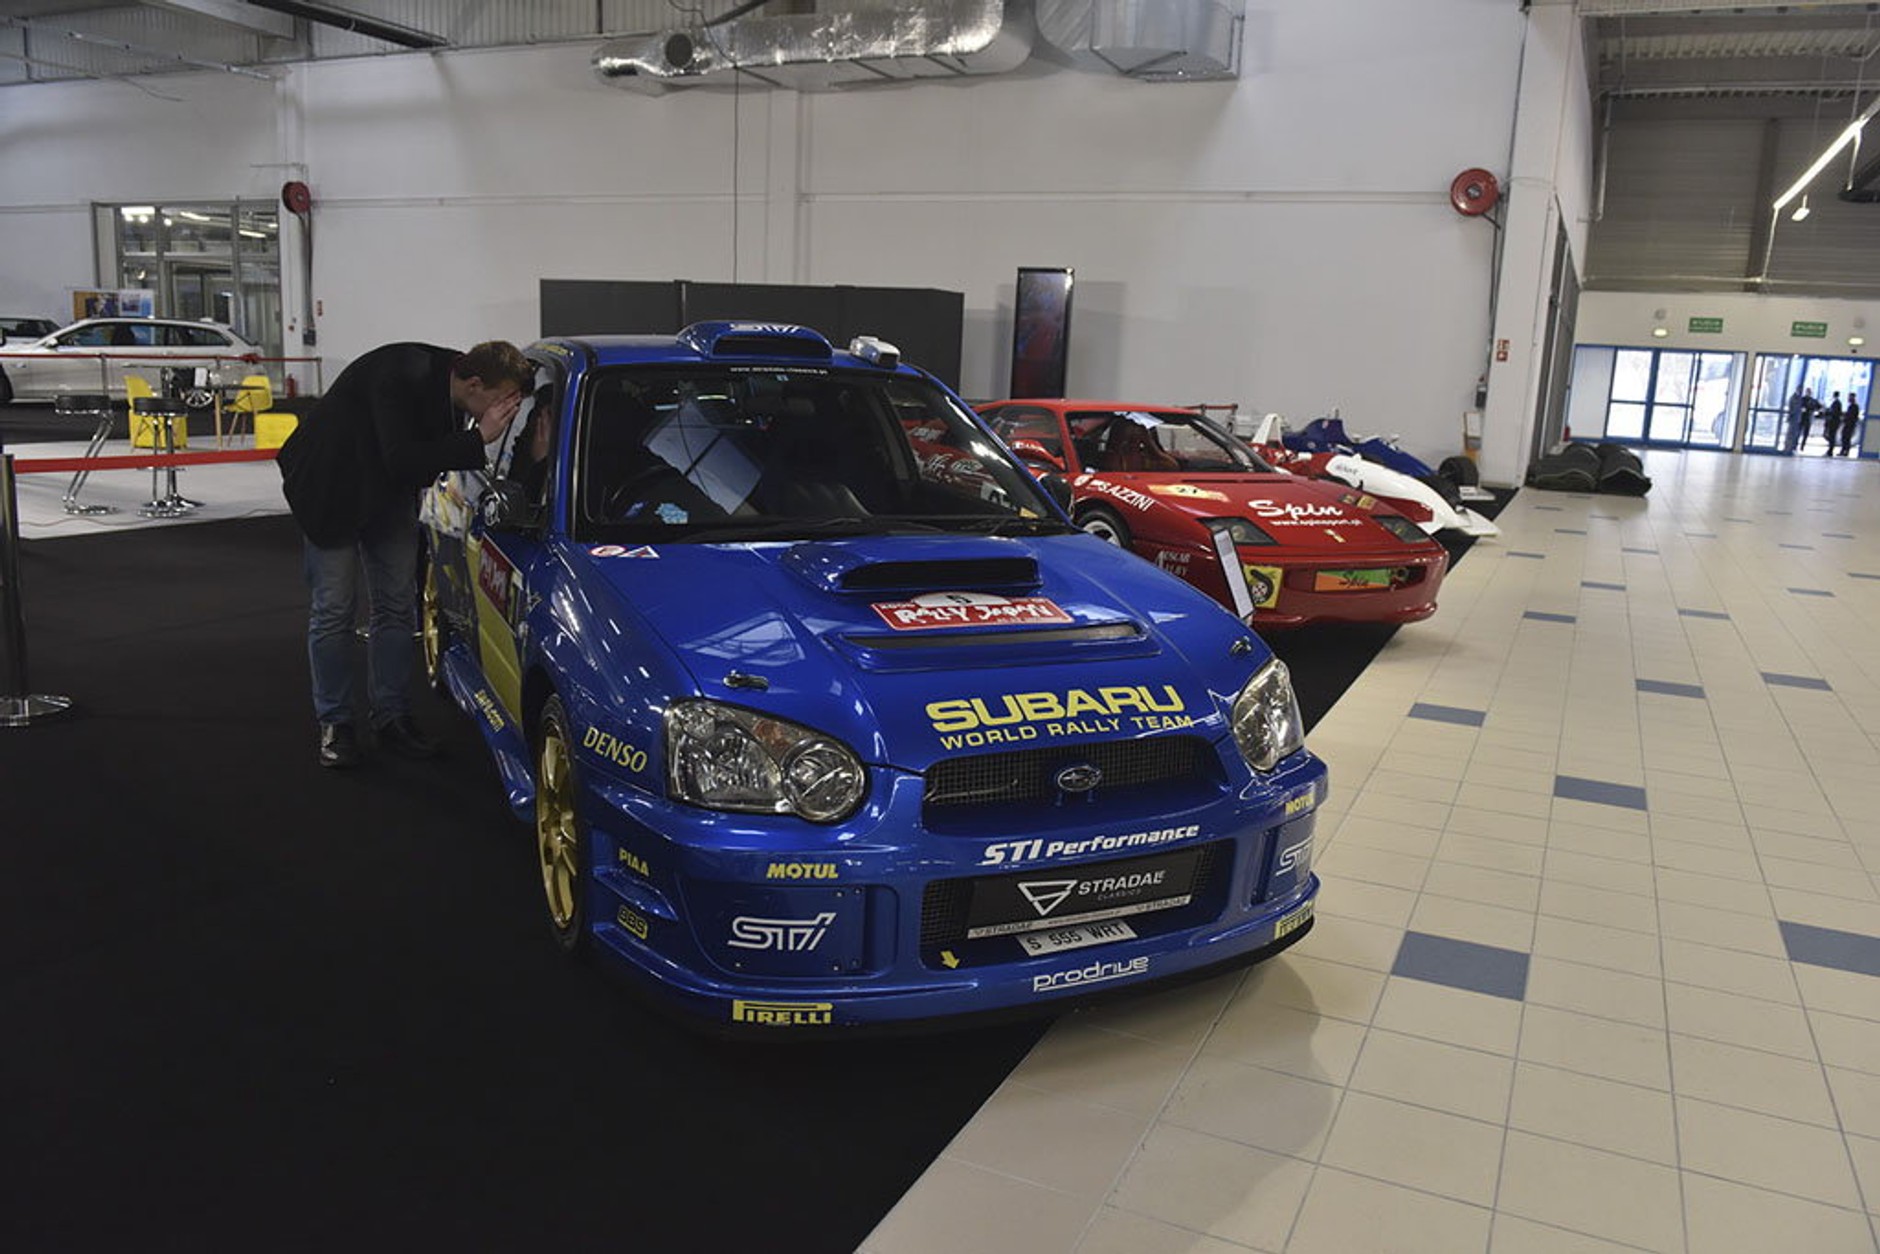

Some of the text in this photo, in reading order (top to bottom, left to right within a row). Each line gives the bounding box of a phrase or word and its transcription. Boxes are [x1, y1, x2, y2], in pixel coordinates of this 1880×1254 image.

[1248, 499, 1343, 521] Spin
[925, 685, 1185, 732] SUBARU
[939, 714, 1195, 751] WORLD RALLY TEAM
[583, 726, 648, 773] DENSO
[619, 847, 650, 877] PIAA
[983, 825, 1200, 866] STI Performance
[766, 863, 839, 880] MOTUL
[1026, 922, 1127, 951] S 555 WRT
[1033, 956, 1149, 992] prodrive
[732, 999, 834, 1024] PIRELLI
